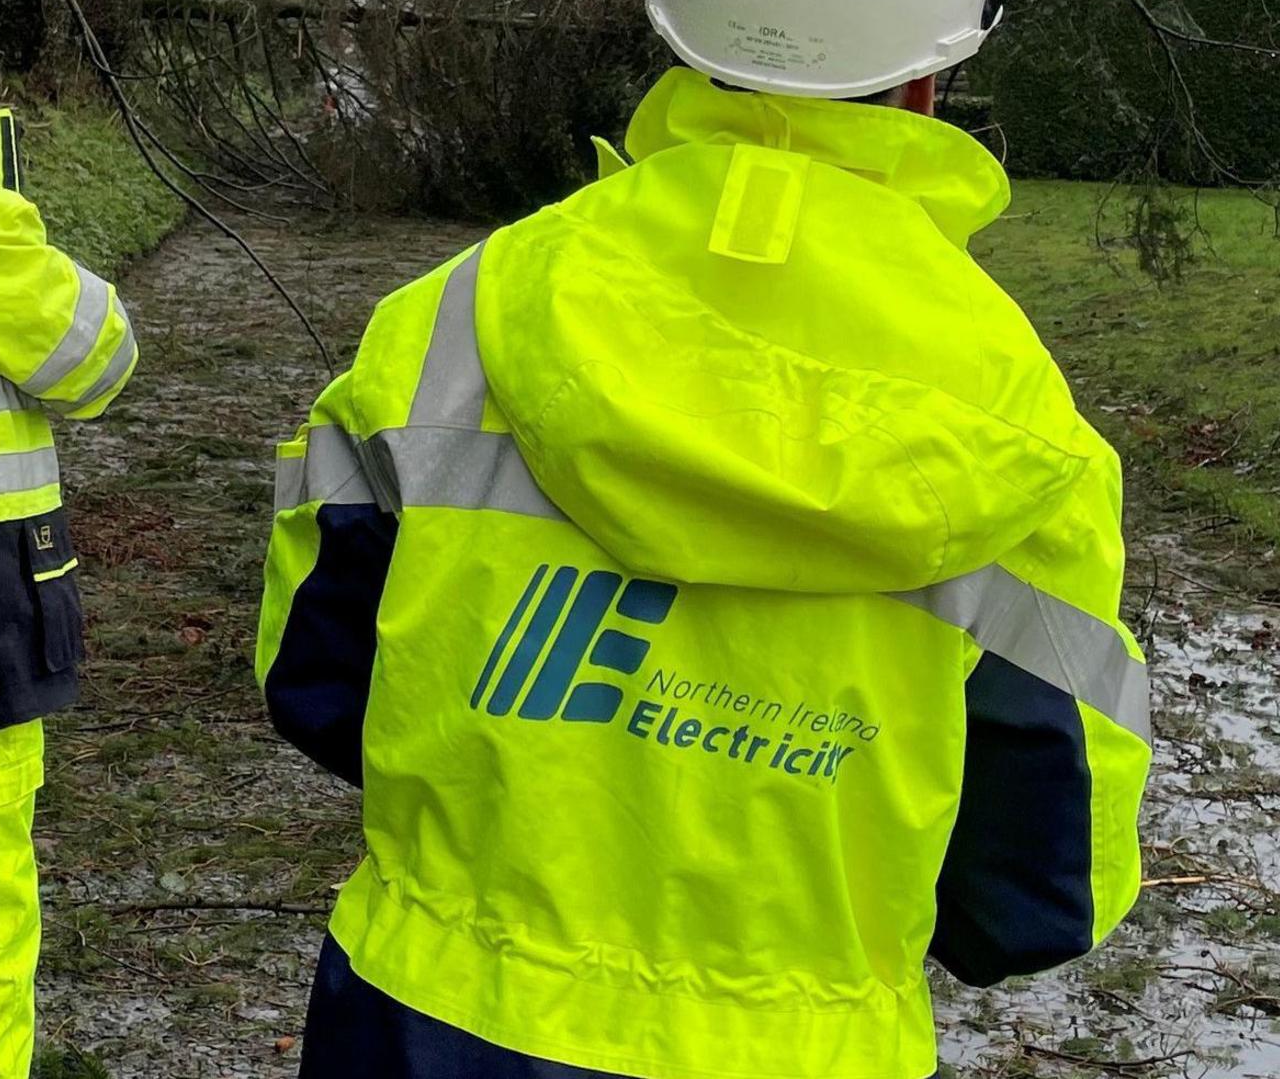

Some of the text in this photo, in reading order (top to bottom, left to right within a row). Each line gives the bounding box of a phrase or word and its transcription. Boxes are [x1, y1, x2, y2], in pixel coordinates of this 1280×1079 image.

[759, 26, 786, 39] IDRA
[646, 669, 881, 742] Northern Ireland
